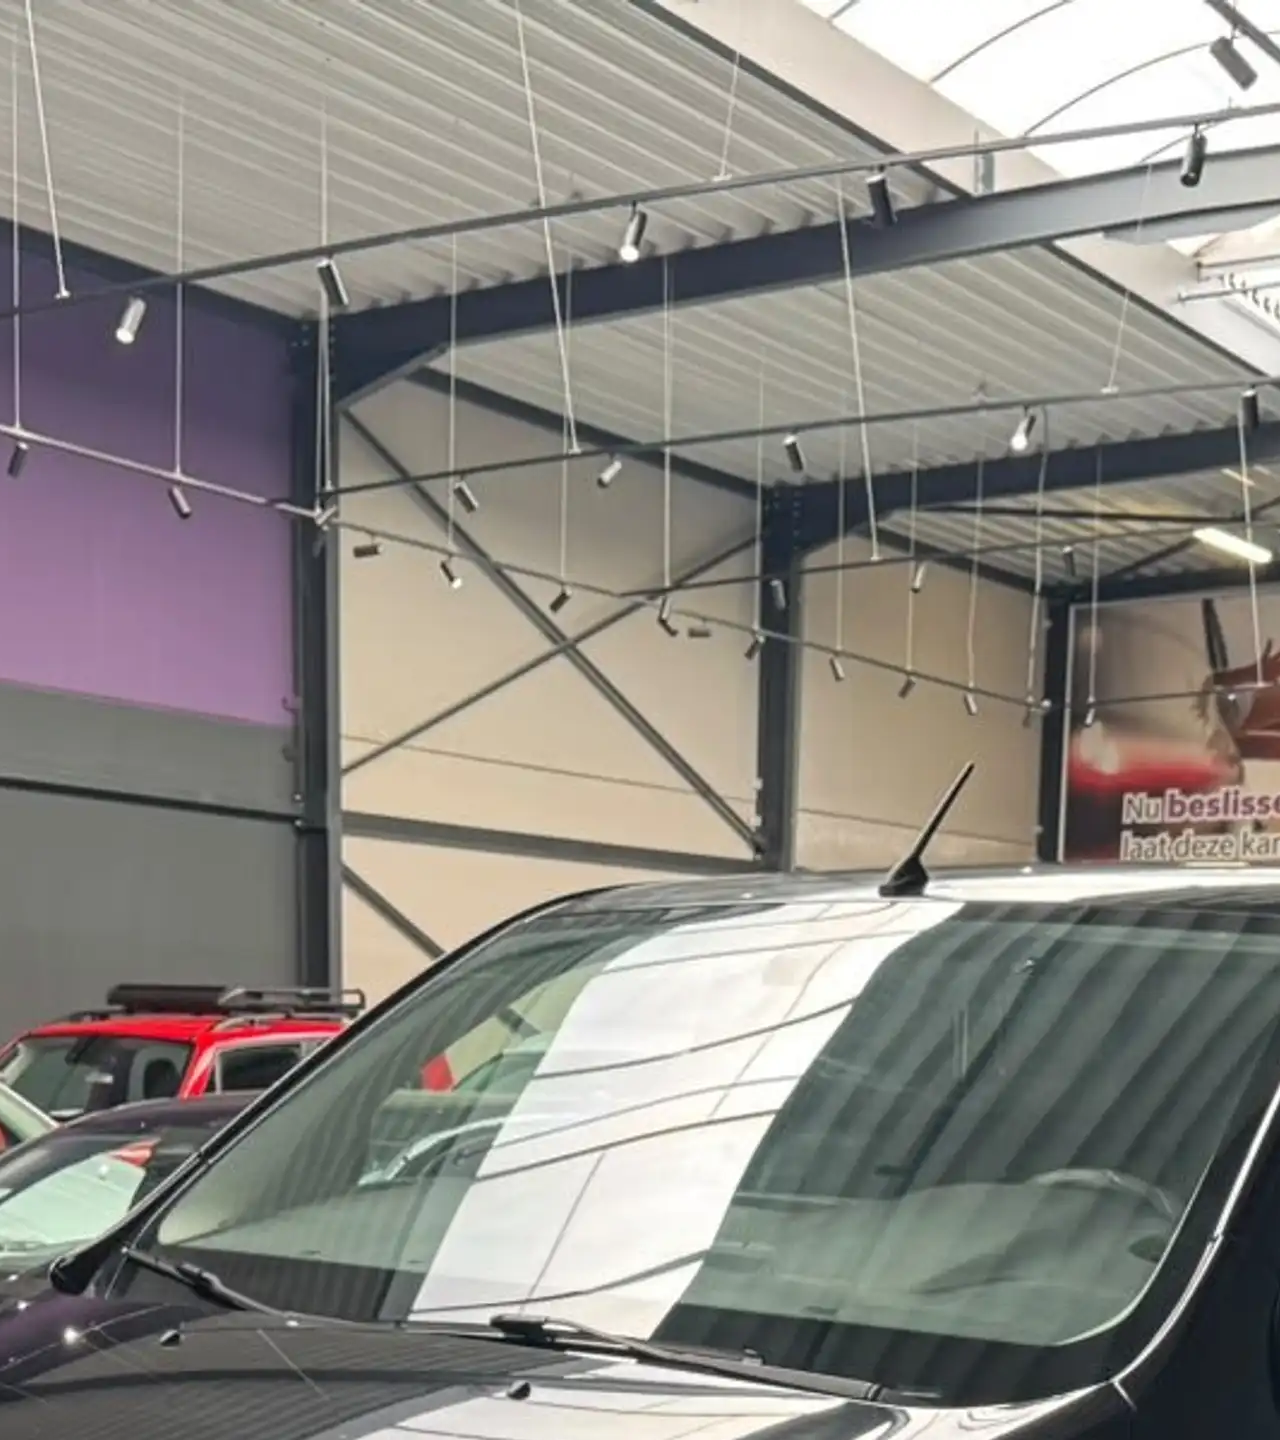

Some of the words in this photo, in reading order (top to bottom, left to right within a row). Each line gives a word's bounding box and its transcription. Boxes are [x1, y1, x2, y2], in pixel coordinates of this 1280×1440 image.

[1125, 796, 1161, 820] Nu
[1122, 831, 1168, 859] laat
[1174, 828, 1234, 856] deze
